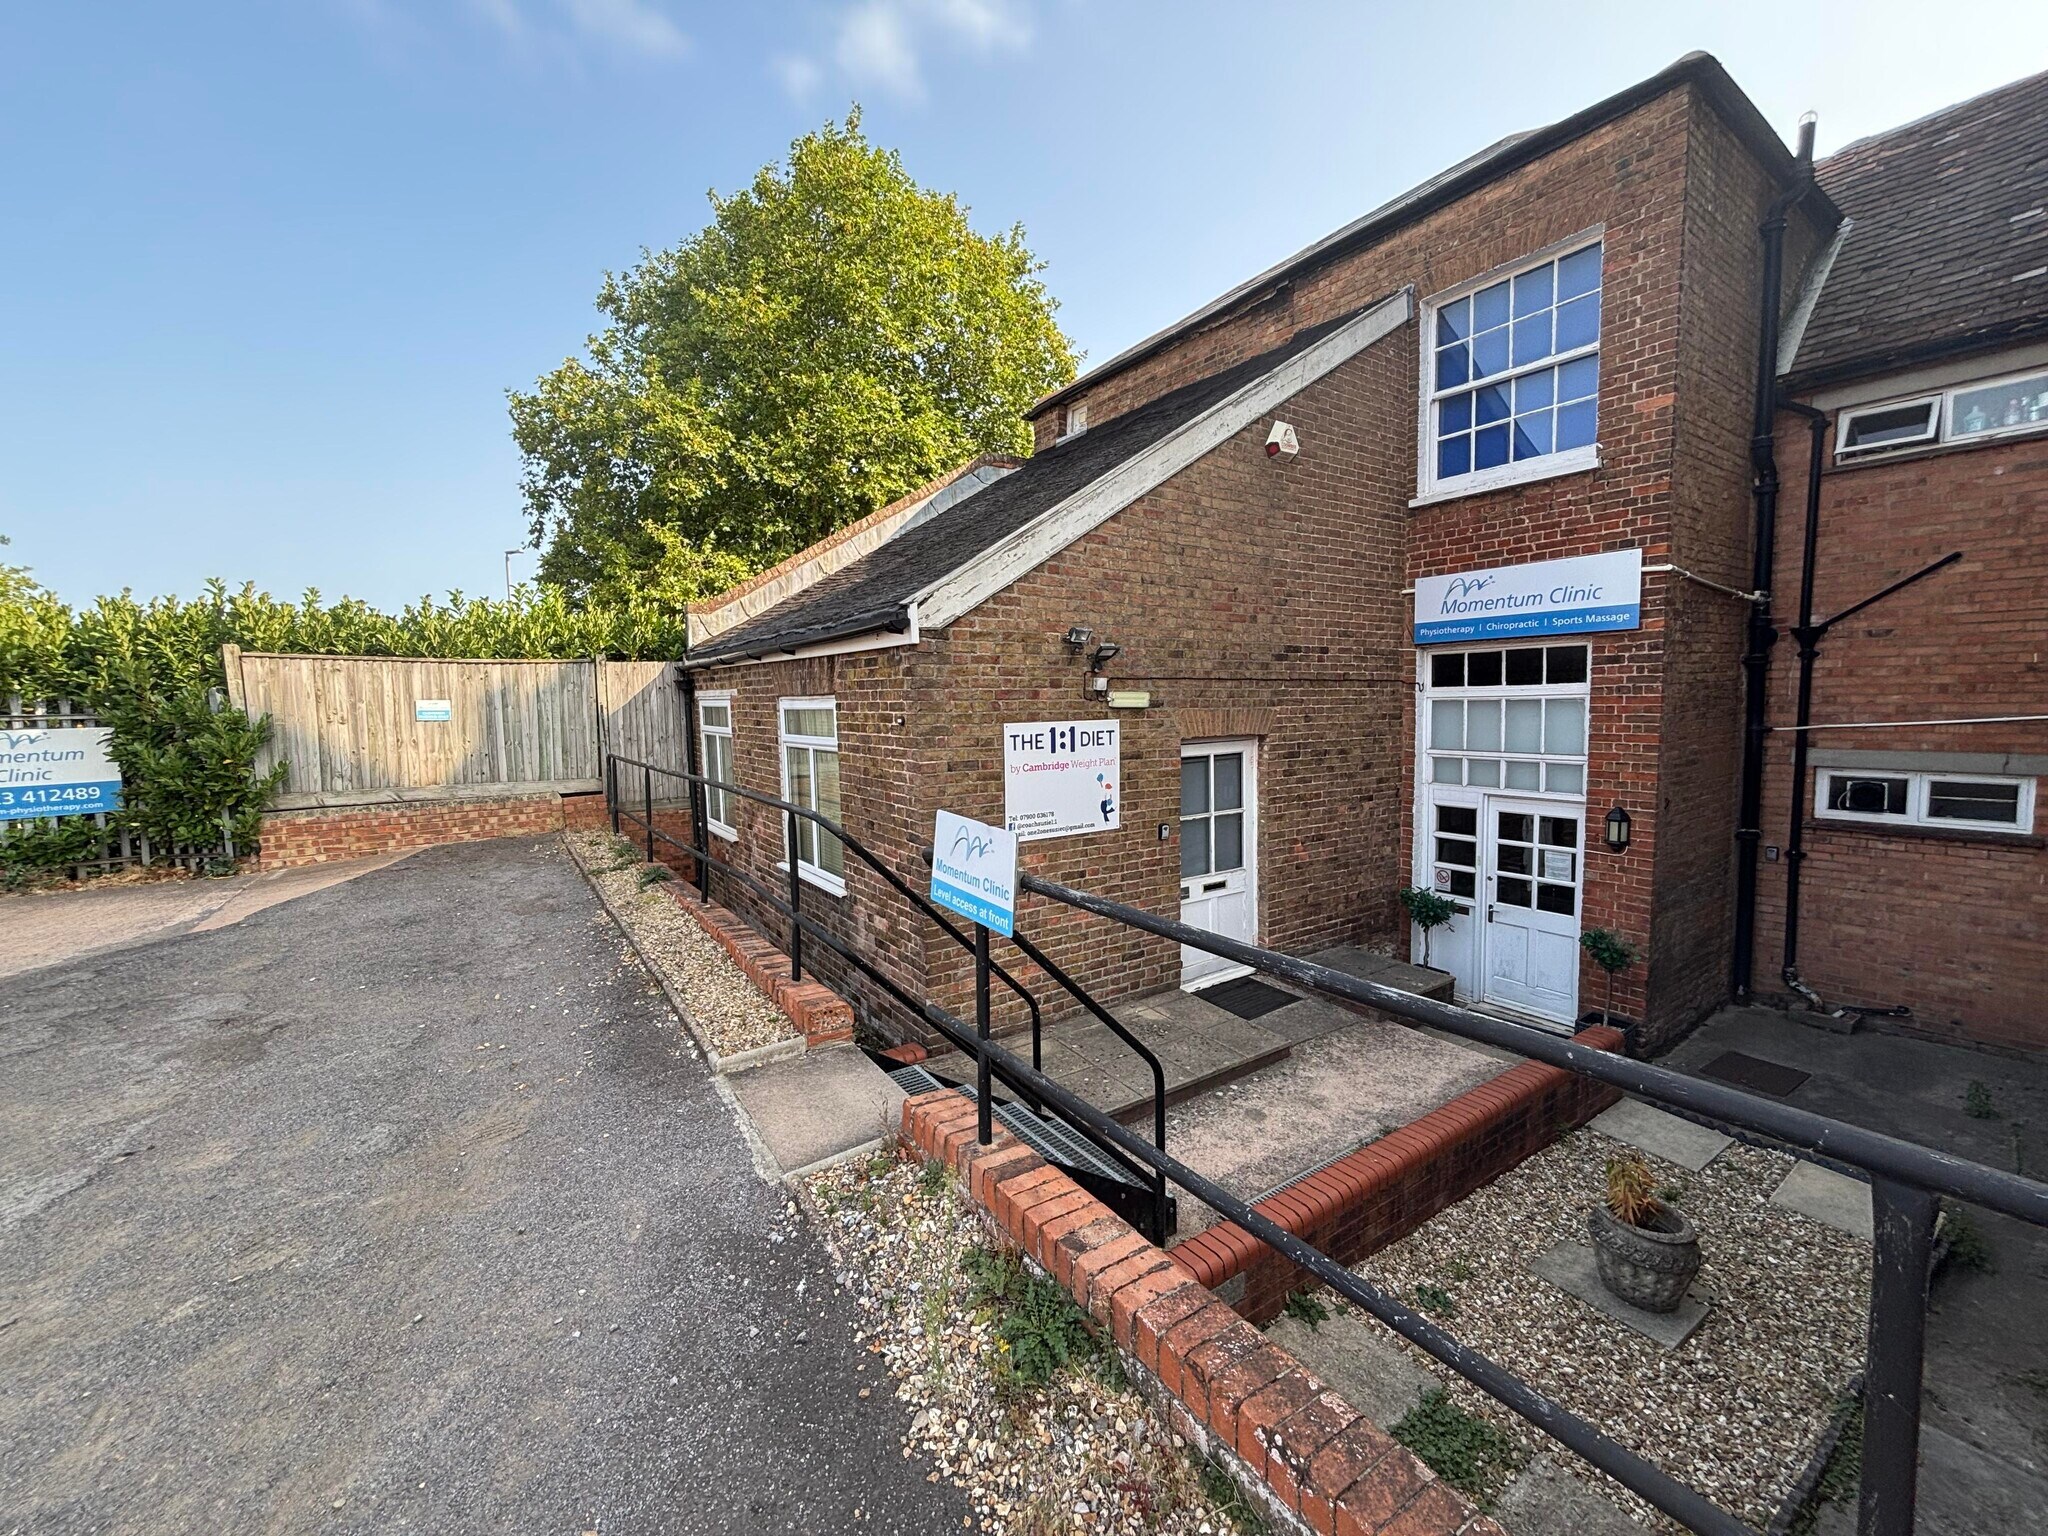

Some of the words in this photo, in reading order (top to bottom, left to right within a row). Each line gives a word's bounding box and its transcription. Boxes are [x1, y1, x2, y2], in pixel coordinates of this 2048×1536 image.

[1440, 592, 1543, 615] Momentum
[1549, 583, 1603, 604] Clinic
[1420, 624, 1475, 638] Physiotherapy
[1486, 618, 1540, 632] Chiropractic
[1552, 615, 1583, 627] Sports
[1585, 612, 1630, 625] Massage
[1009, 733, 1045, 751] THE
[1049, 726, 1076, 754] 1:1
[1080, 730, 1115, 747] DIET
[1010, 764, 1021, 775] by
[1022, 761, 1070, 773] Cambridge
[1070, 759, 1098, 769] Weight
[1099, 758, 1115, 767] Plan
[22, 787, 100, 803] 412489
[936, 858, 980, 889] Momentum
[982, 877, 1010, 901] Clinic
[934, 885, 951, 898] Level
[952, 895, 977, 915] access
[979, 908, 987, 918] at
[988, 909, 1009, 930] front
